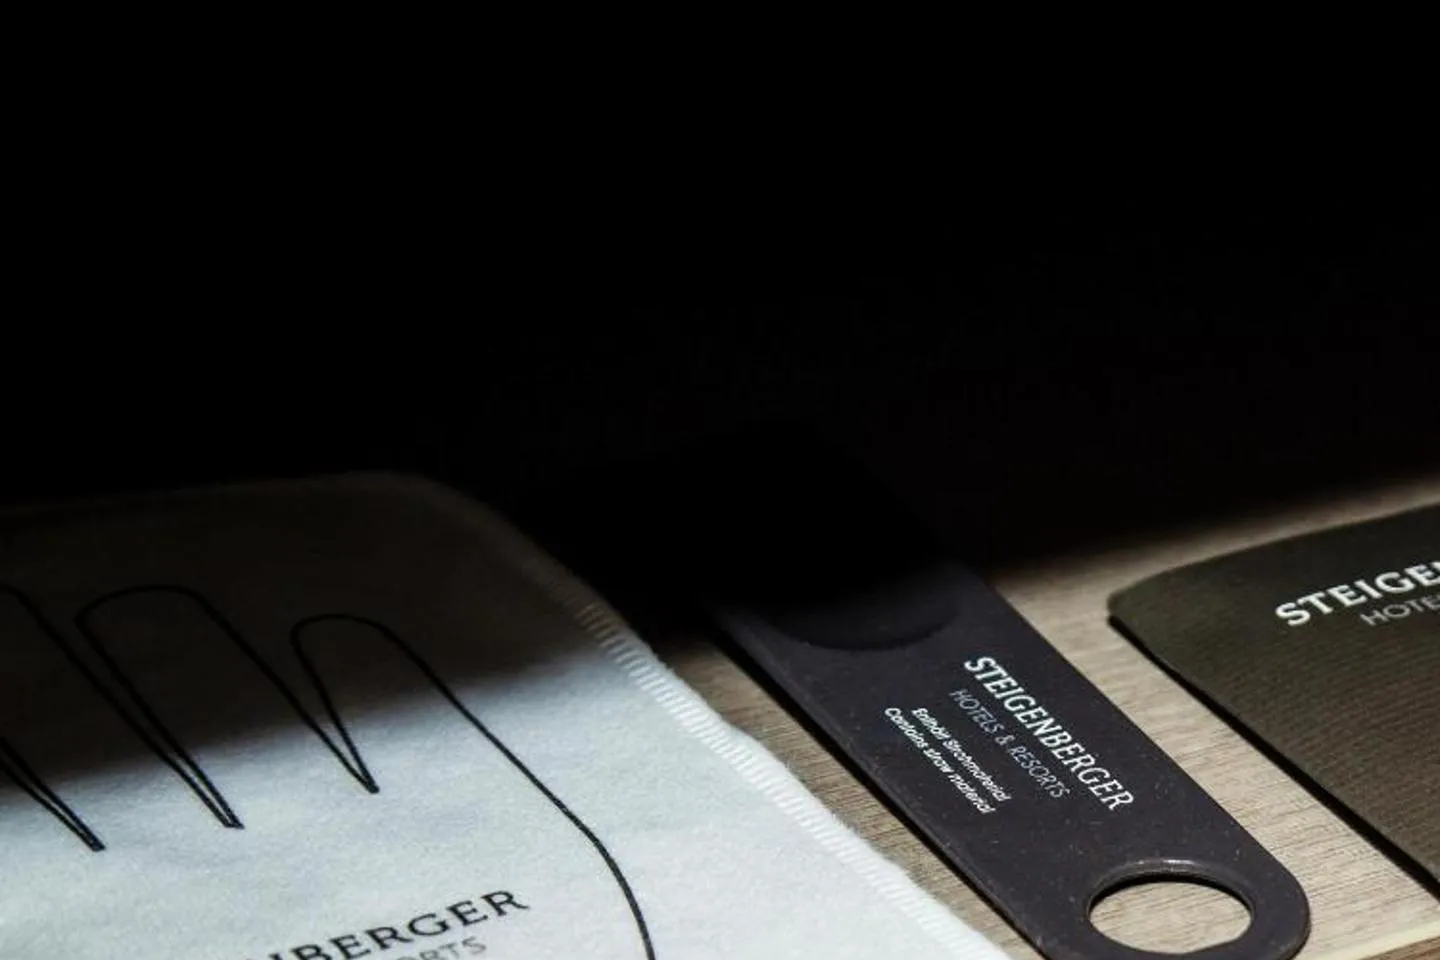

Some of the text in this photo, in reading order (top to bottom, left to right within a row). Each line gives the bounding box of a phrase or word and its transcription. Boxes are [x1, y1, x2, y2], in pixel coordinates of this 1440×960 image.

[885, 708, 996, 813] Contains straw material
[949, 688, 1070, 799] HOTELS & RESORTS
[964, 656, 1134, 811] STEIGENBERGER
